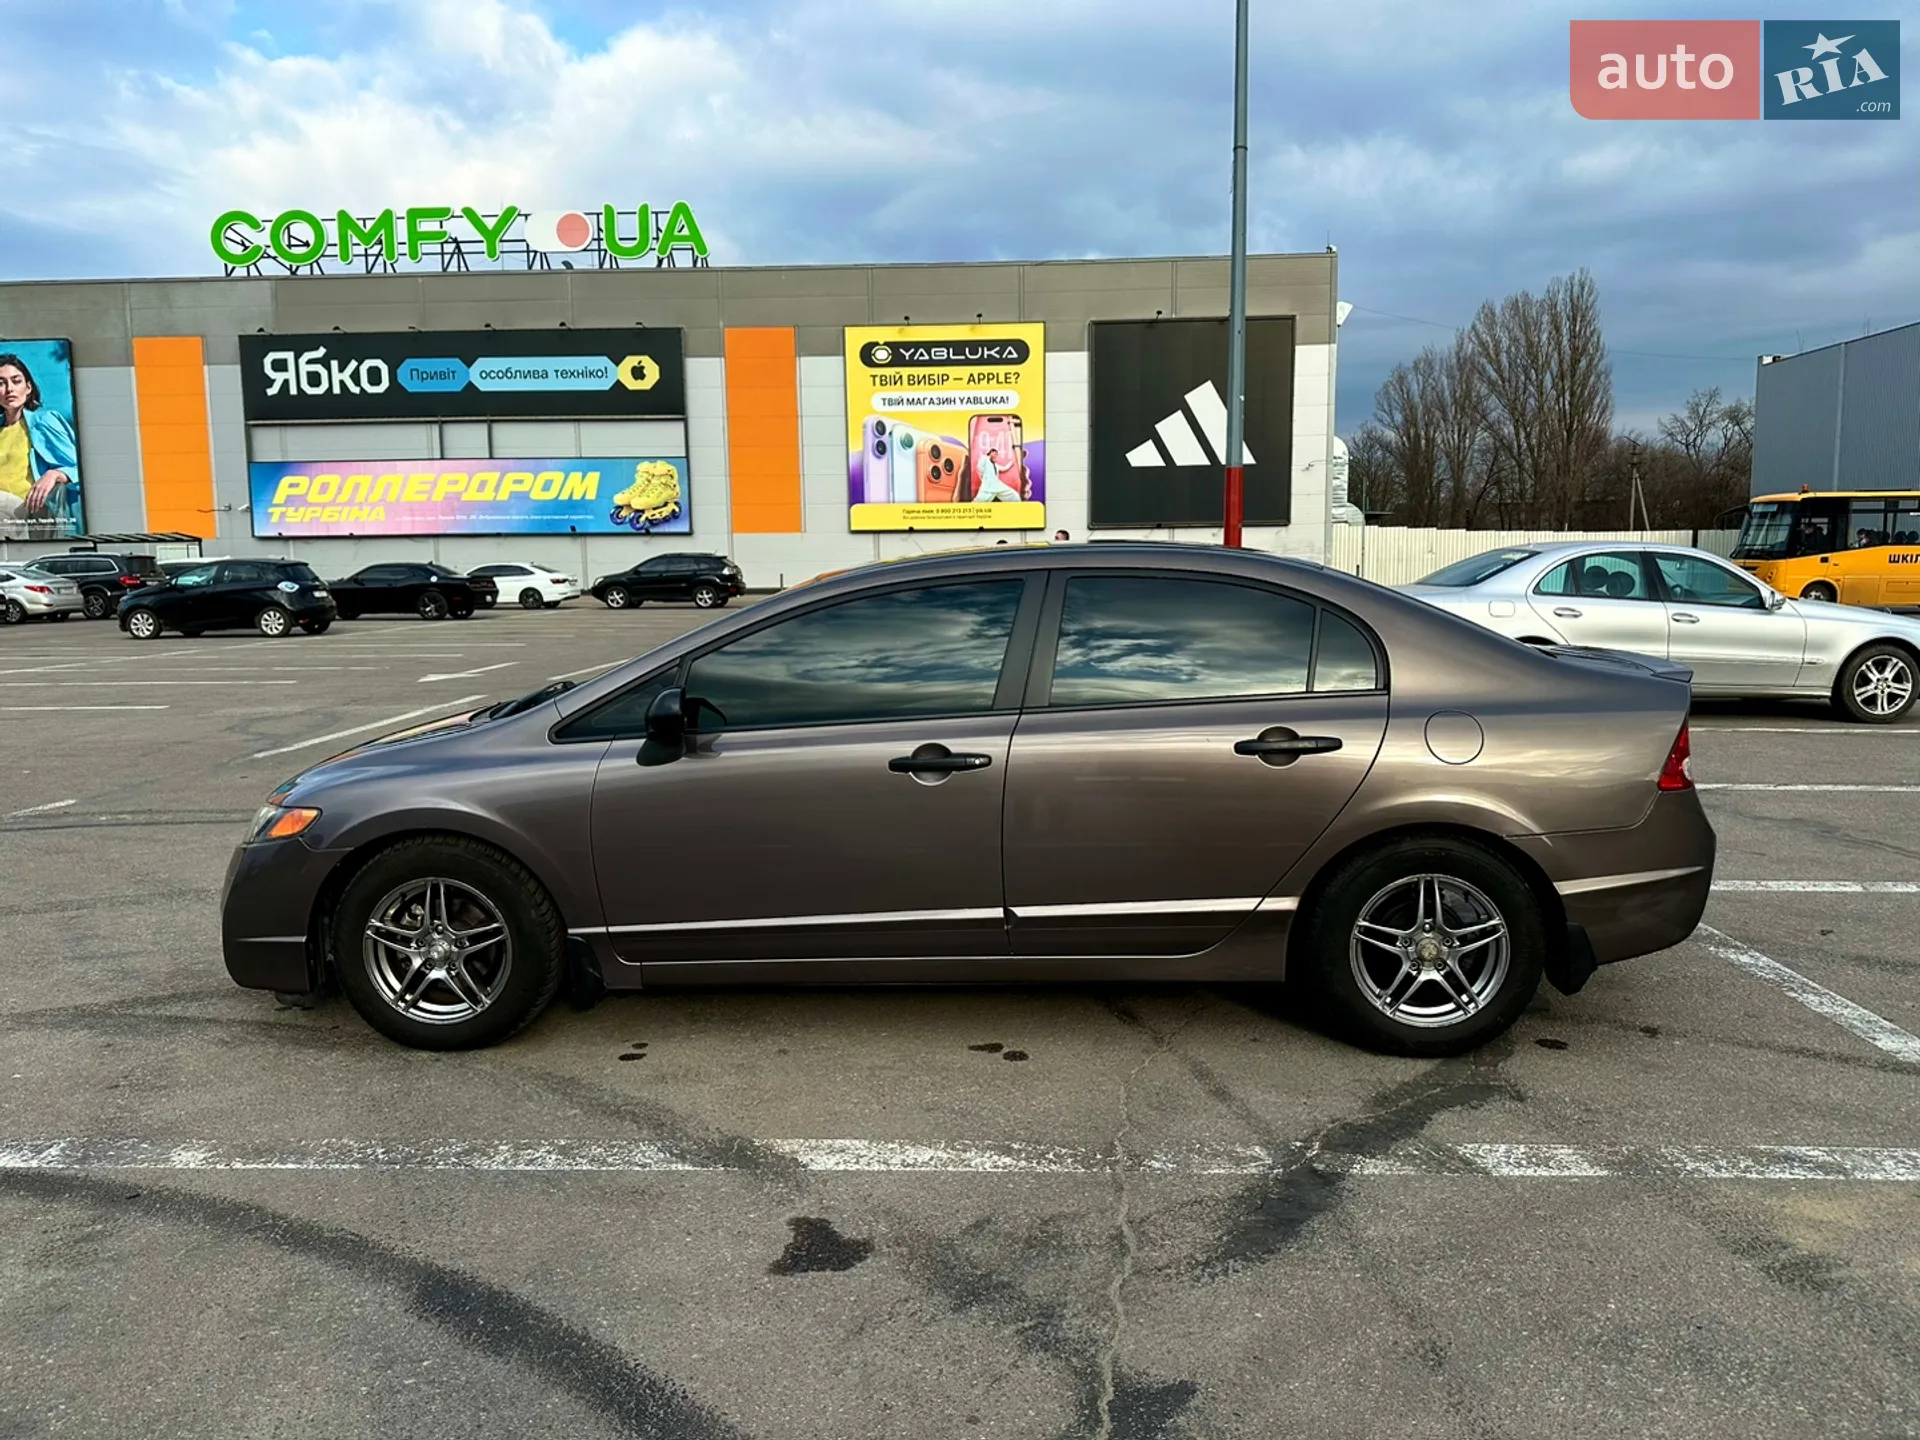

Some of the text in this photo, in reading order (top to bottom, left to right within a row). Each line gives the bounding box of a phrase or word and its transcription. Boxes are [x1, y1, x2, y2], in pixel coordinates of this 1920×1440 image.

[210, 200, 709, 267] COMFY UA
[900, 346, 1019, 361] YABLUKA
[263, 346, 608, 396] Ябко Привіт особлива техніко!
[870, 371, 903, 387] ТВІЙ
[907, 373, 949, 387] ВИБІР
[967, 372, 1020, 385] APPLE?
[881, 395, 1010, 407] ТВІЙ МАГАЗИН YABLUKA!
[272, 472, 600, 504] РОЛЛЕРДРОМ
[267, 505, 386, 523] ТУРБІНА
